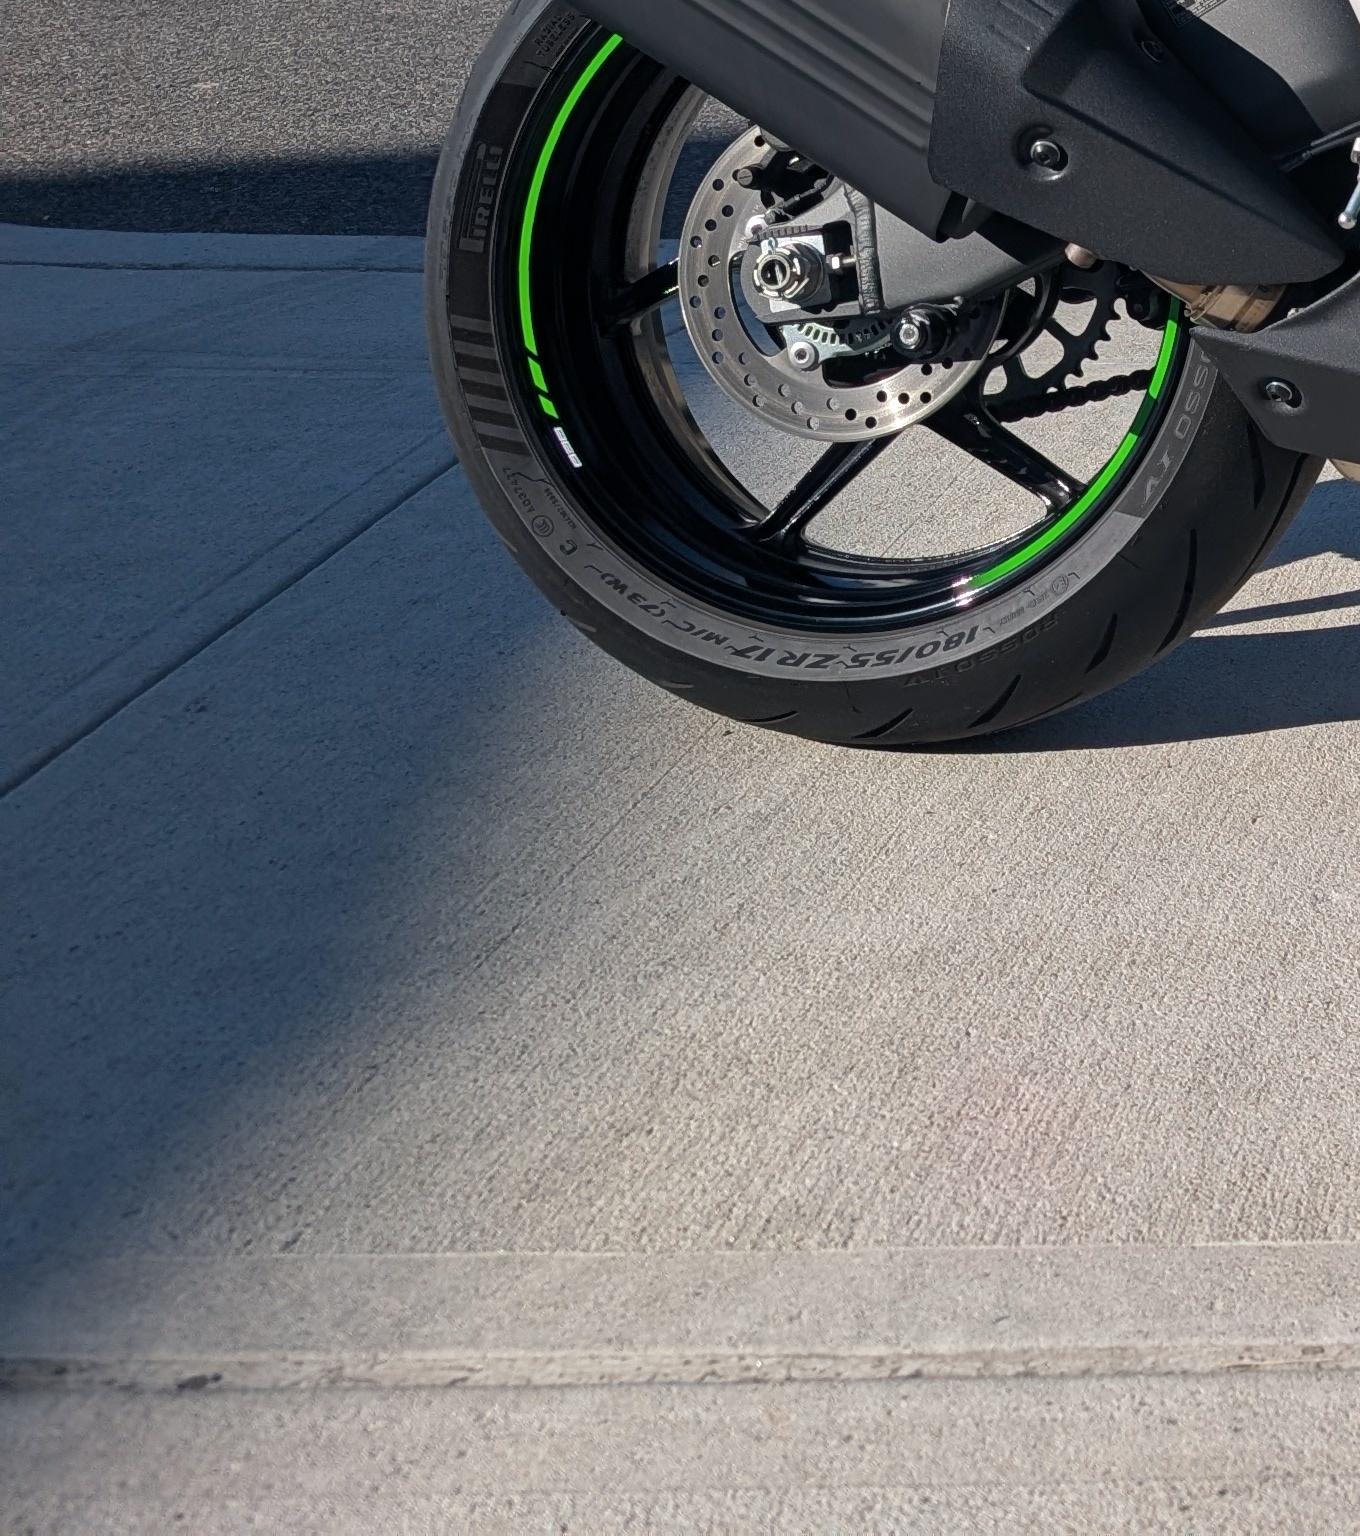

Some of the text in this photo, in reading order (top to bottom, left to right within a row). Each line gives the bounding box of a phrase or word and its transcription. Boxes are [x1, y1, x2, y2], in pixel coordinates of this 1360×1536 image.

[457, 140, 503, 253] PIRELLI
[729, 643, 776, 662] 17
[774, 648, 840, 669] ZR
[850, 624, 980, 668] 180/55
